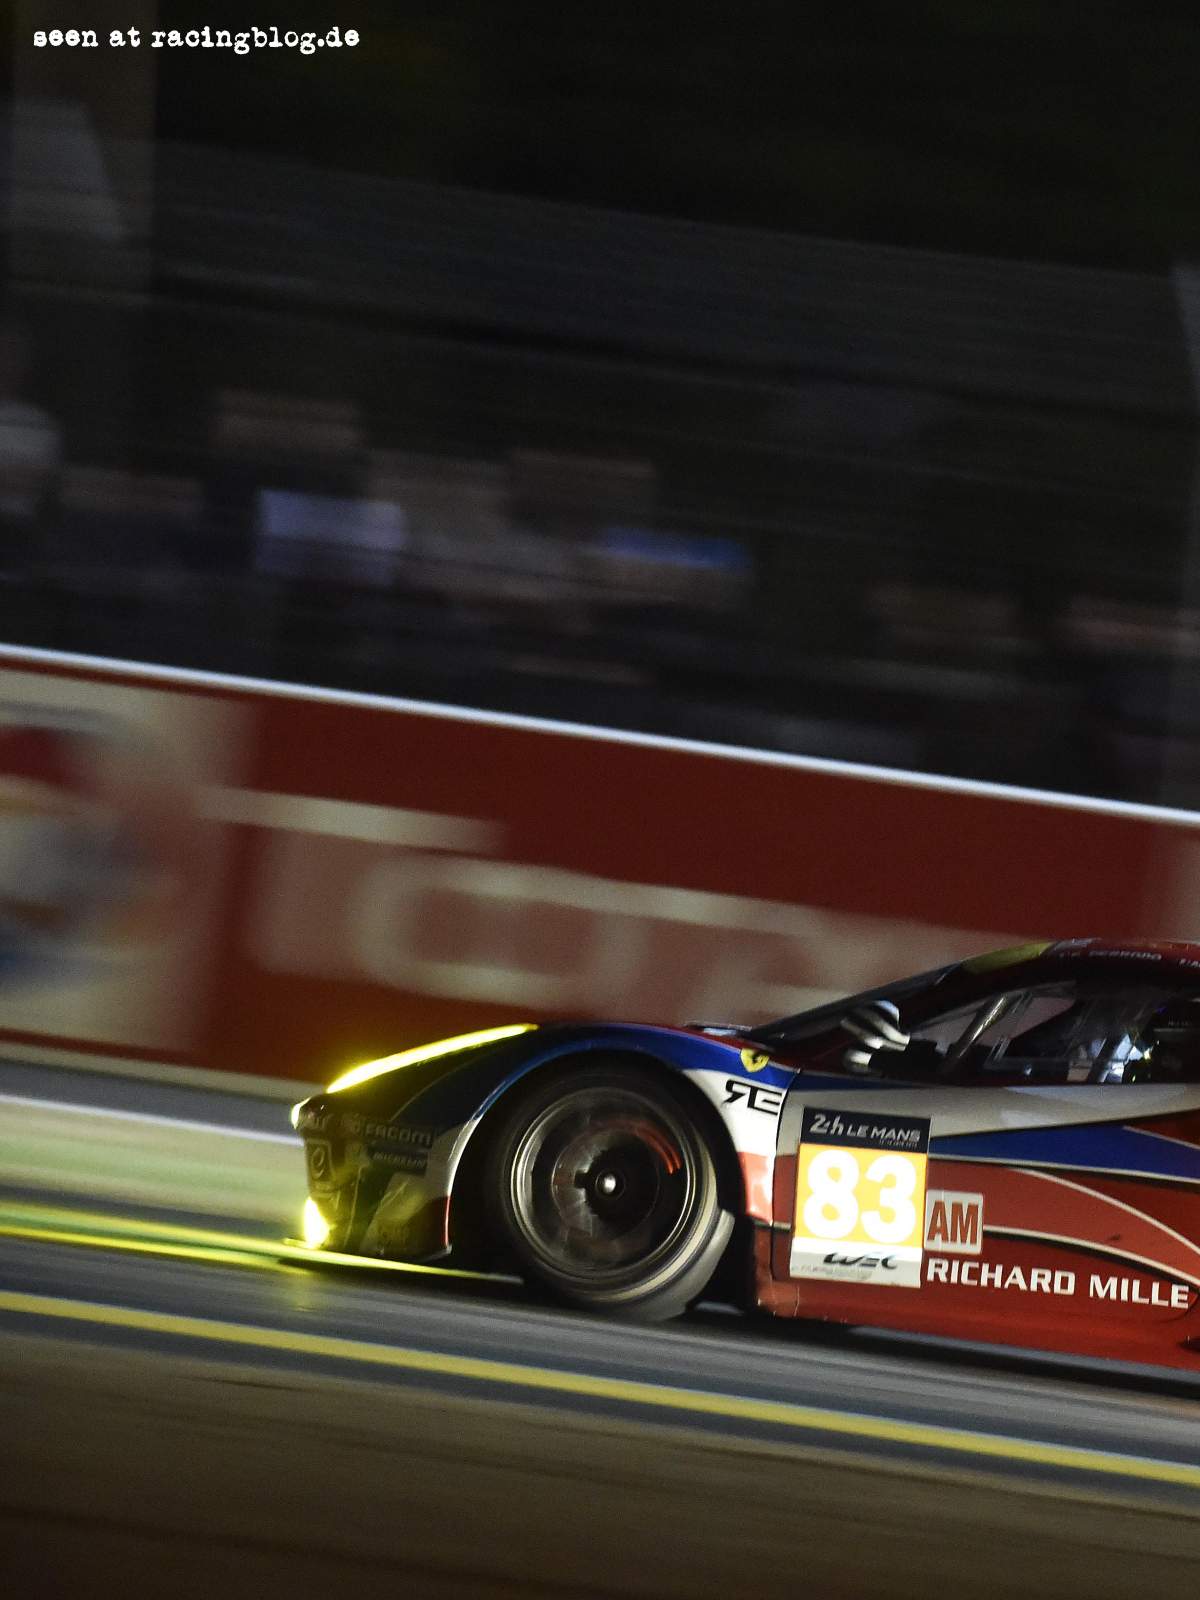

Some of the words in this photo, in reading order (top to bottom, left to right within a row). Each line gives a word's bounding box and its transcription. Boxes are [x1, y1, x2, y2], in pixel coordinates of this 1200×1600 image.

[846, 1124, 867, 1138] LE
[870, 1126, 921, 1142] MANS
[803, 1149, 917, 1244] 83
[926, 1200, 979, 1246] AM
[823, 1251, 899, 1270] WEC
[926, 1257, 1076, 1296] RICHARD
[1089, 1274, 1190, 1309] MILLE
